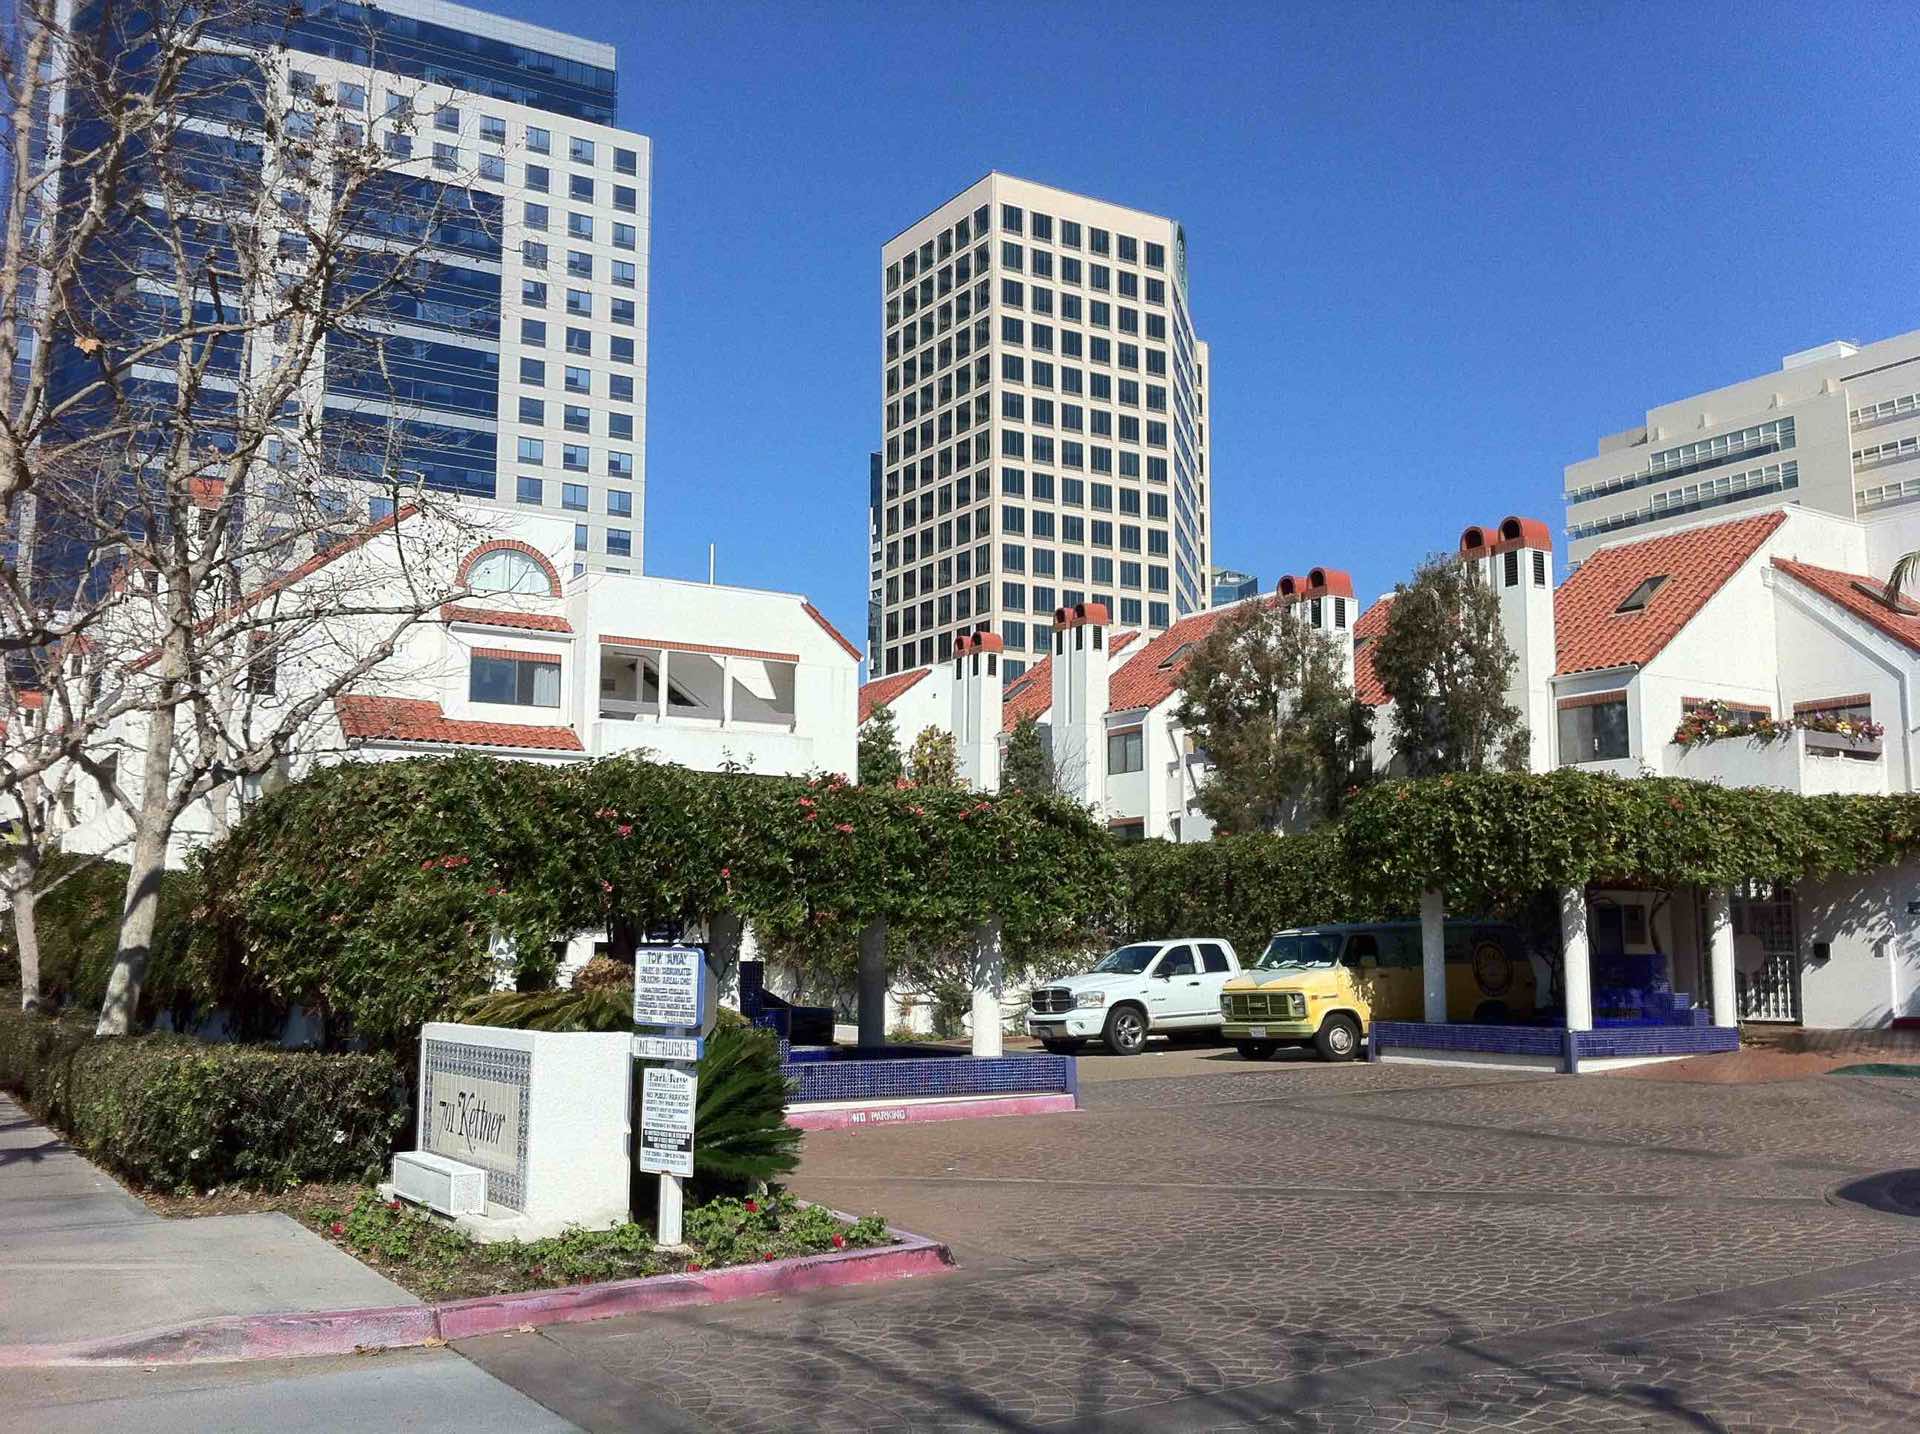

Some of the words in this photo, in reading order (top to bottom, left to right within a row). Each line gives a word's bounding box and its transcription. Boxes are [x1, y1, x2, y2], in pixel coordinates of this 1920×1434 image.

[647, 952, 663, 964] TOW
[667, 953, 688, 965] AWAY
[437, 1101, 456, 1147] 701
[458, 1091, 506, 1153] Kettner
[852, 1112, 866, 1123] NO
[871, 1109, 906, 1121] PARKING
